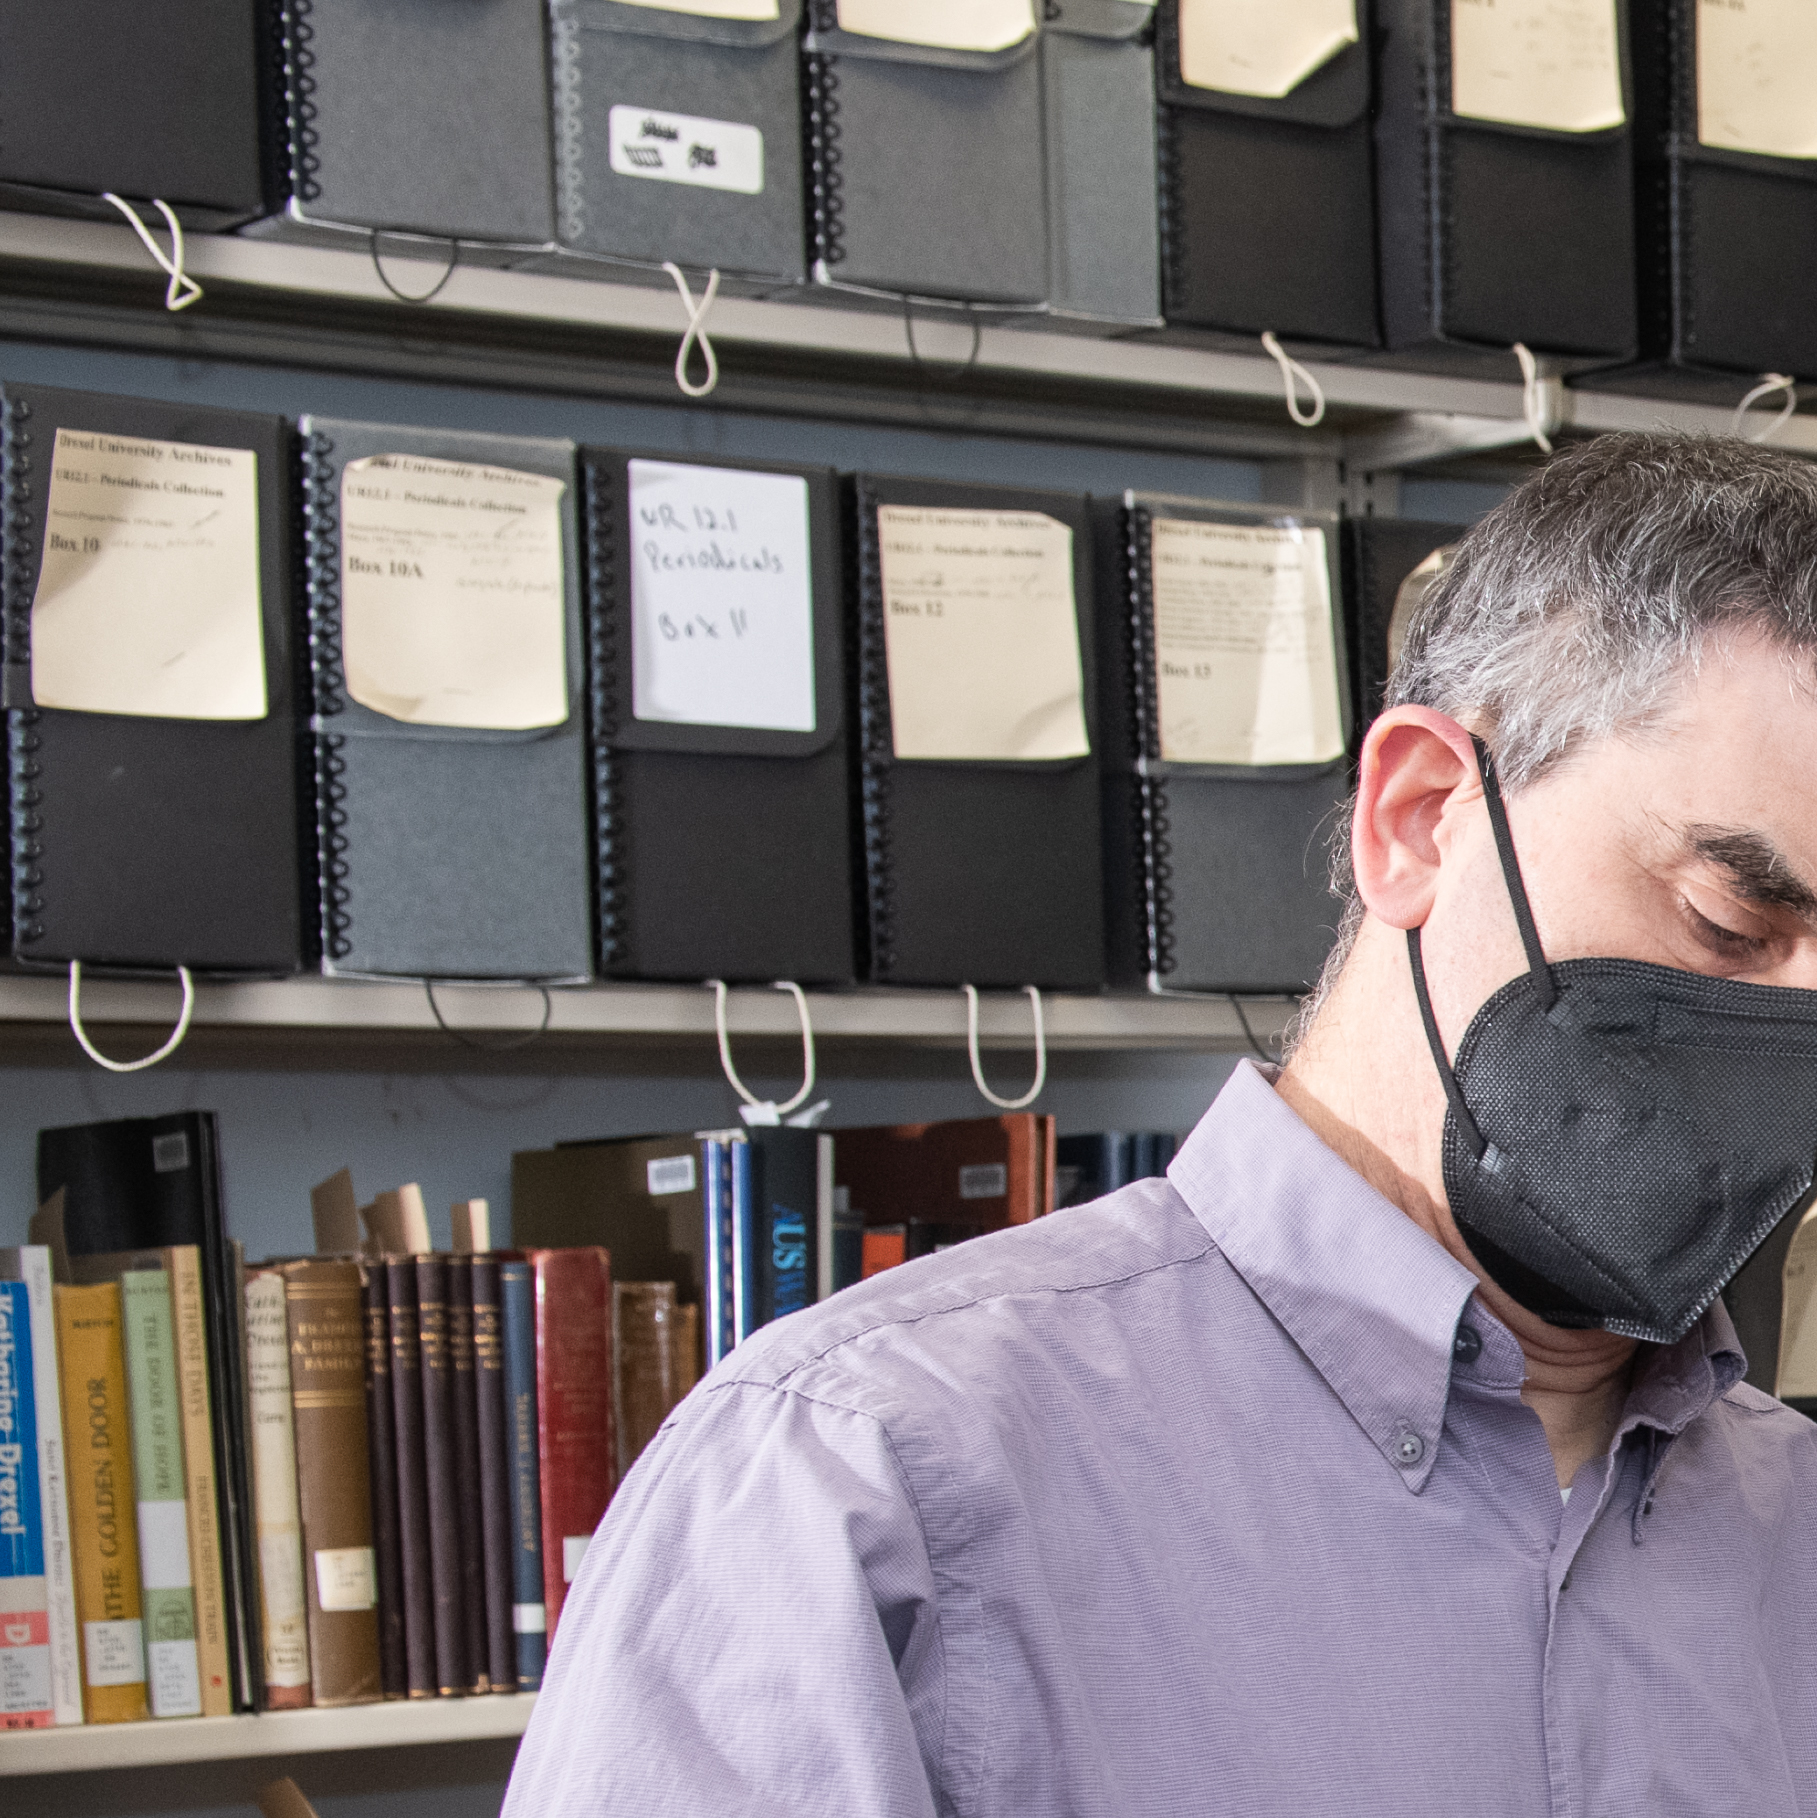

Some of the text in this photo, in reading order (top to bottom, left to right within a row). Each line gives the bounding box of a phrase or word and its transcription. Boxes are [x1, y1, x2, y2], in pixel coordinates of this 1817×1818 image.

[59, 434, 231, 466] Drexel University Archives
[694, 505, 737, 533] 12.1
[51, 533, 100, 553] Box 10
[643, 540, 784, 574] Periodicals
[349, 556, 423, 578] Box 10A
[182, 1270, 205, 1417] IN THOSE DAYS
[87, 1377, 111, 1449] DOOR
[1, 1443, 26, 1535] Drexel
[95, 1460, 118, 1557] GOLDEN
